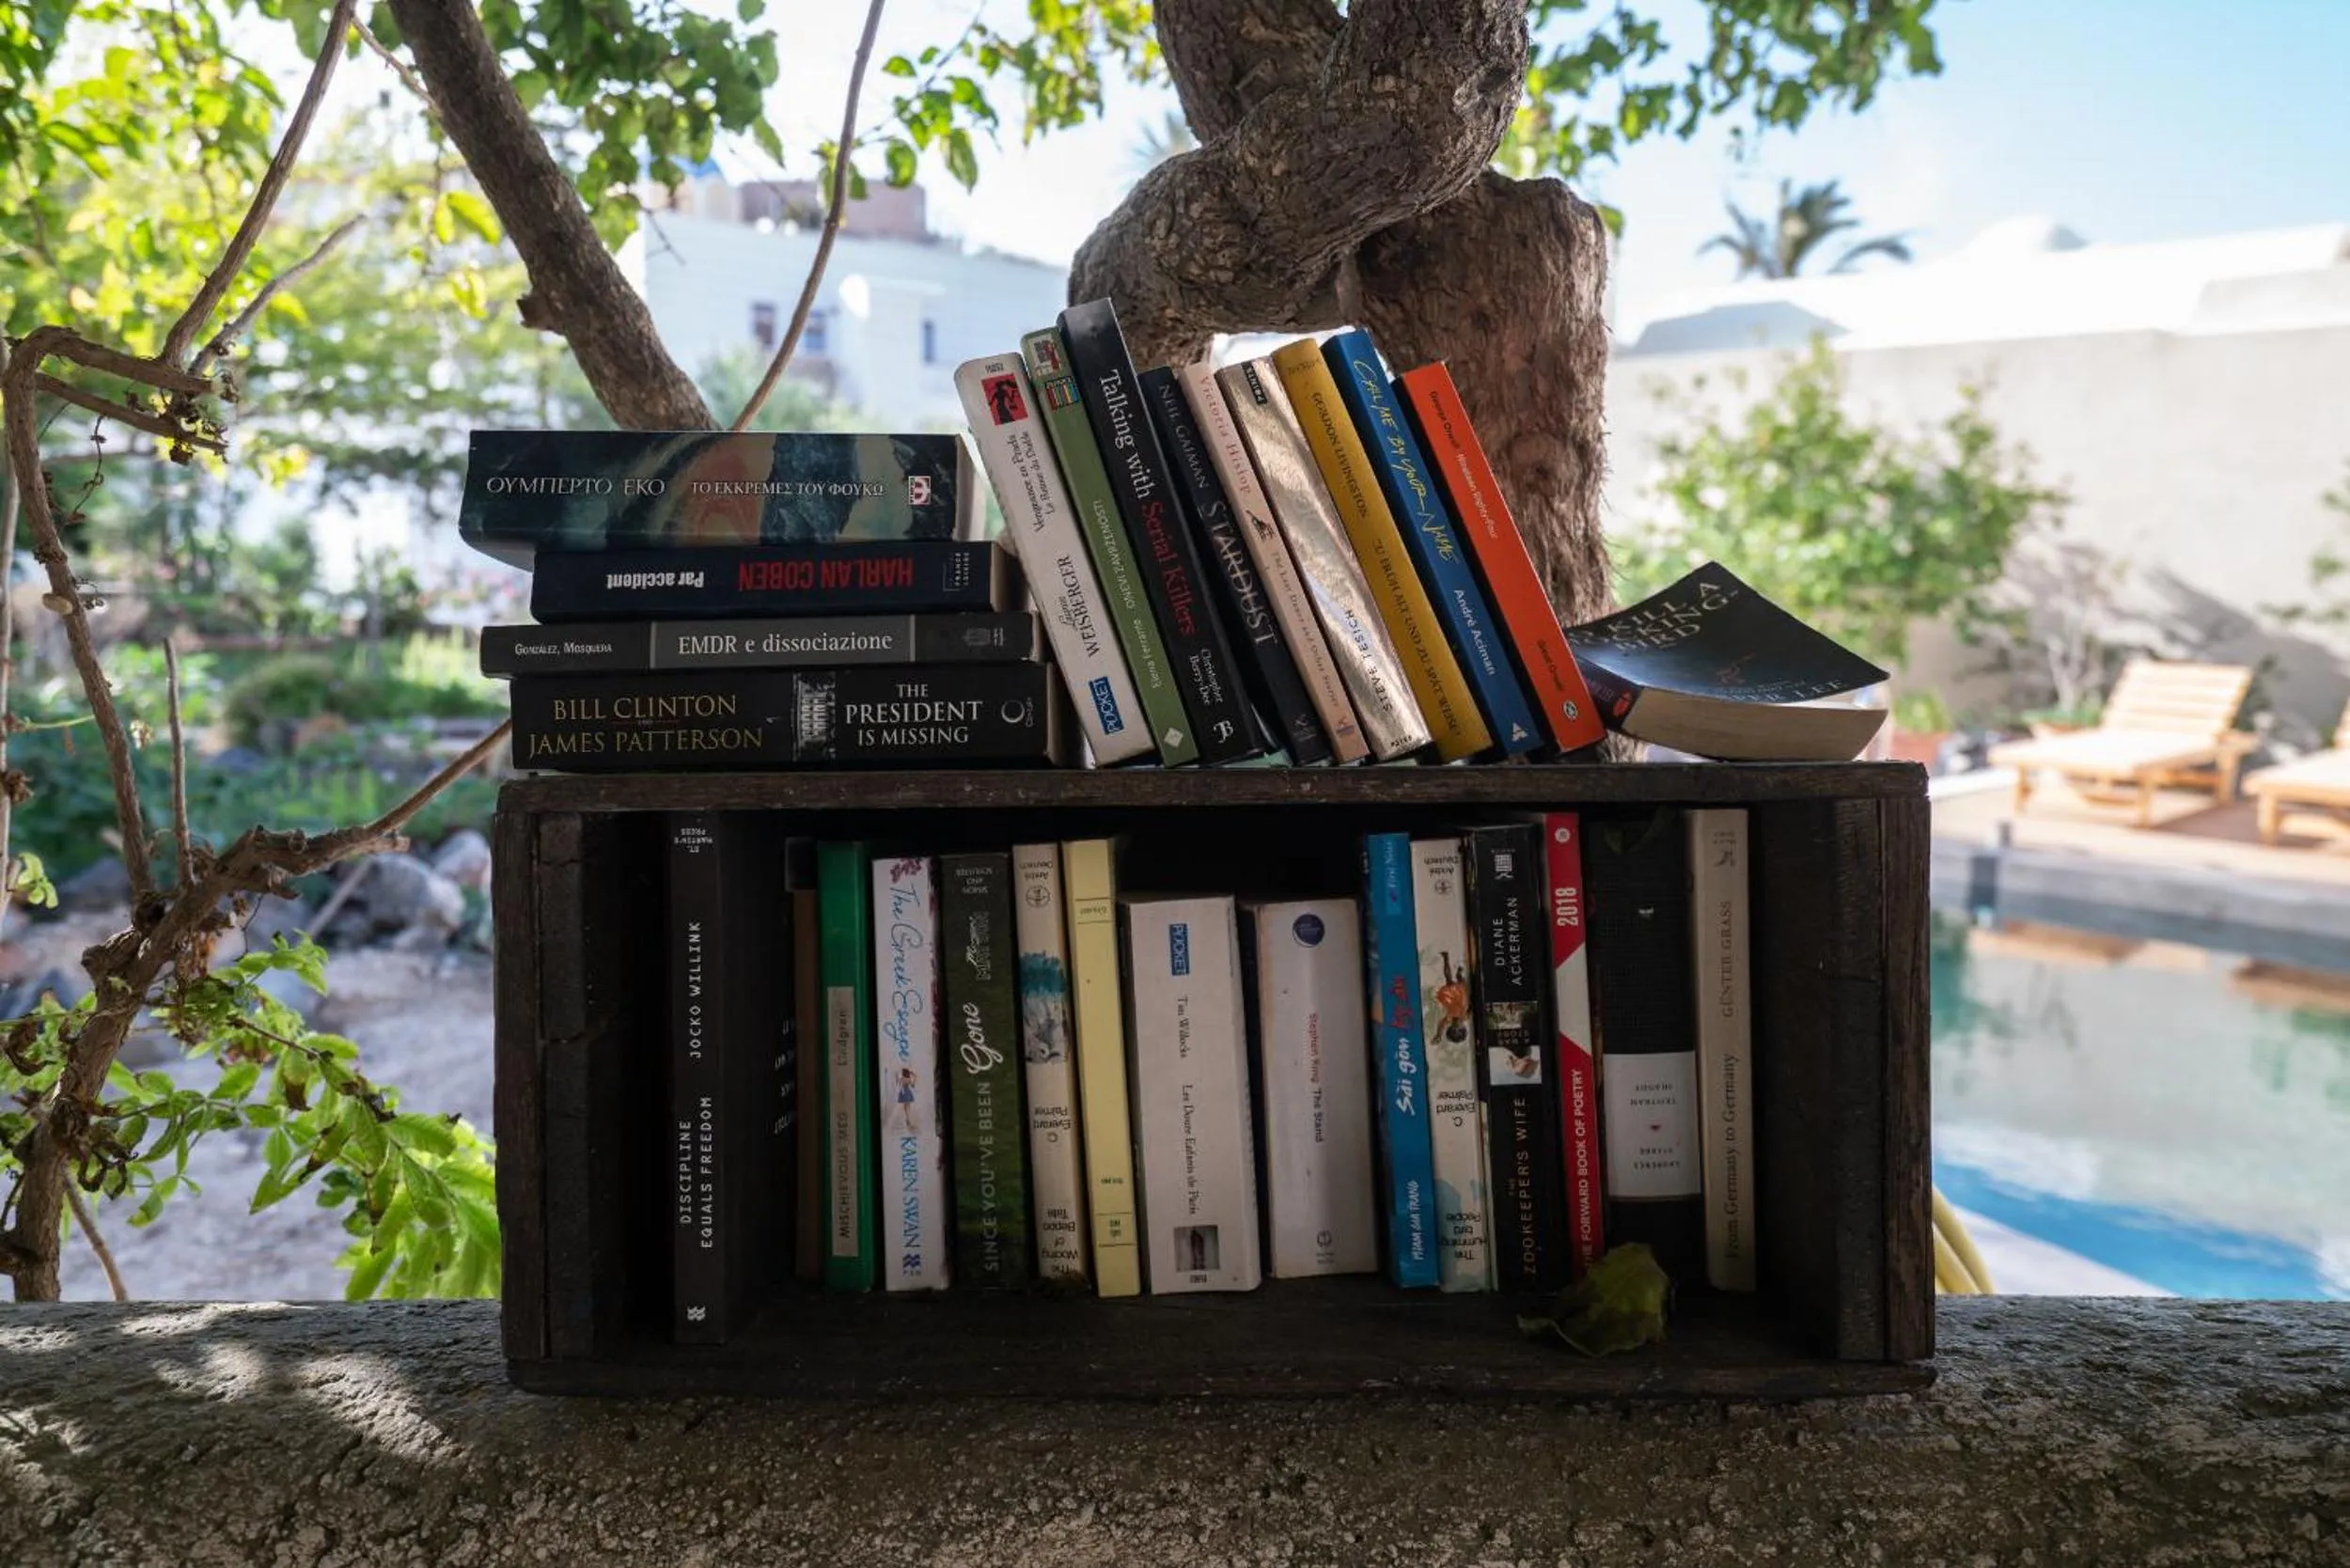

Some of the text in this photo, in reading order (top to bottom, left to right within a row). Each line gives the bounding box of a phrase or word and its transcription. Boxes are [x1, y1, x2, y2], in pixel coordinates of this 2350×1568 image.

[1007, 433, 1025, 464] Prada
[1158, 384, 1209, 489] NEIL GAIMAN
[1199, 376, 1251, 494] Victoria Hislop
[1311, 388, 1375, 519] GORDON LIVINGSTON
[1353, 360, 1383, 402] CALL
[1370, 404, 1397, 428] ME
[1390, 458, 1427, 515] YOUR
[1418, 511, 1454, 561] NAME
[486, 476, 666, 496] ΟΥΜΠΕΡΤΟ ΕΚΟ
[691, 481, 885, 498] ΤΟ ΕΚΚΡΕΜΕΣ ΤΟΥ ΦΟΥΚΩ
[1456, 453, 1477, 492] Nineteen
[1025, 482, 1045, 532] Vengeance
[1099, 368, 1199, 635] Talking with Serial Killers
[605, 570, 705, 589] Par accident
[737, 557, 915, 593] HARLAN COBEN
[1116, 574, 1136, 609] DNEVI
[1197, 502, 1277, 645] STARDUST
[1057, 556, 1100, 657] WEISBERGER
[1453, 589, 1496, 675] André Aciman
[677, 633, 893, 655] EMDR e dissociazione
[1133, 619, 1162, 689] Elena Ferrante
[1344, 608, 1395, 713] STEVE TESICH
[896, 683, 930, 698] THE
[1200, 648, 1224, 703] Christopher
[553, 695, 736, 721] BILL CLINTON
[845, 699, 982, 725] PRESIDENT
[1089, 674, 1125, 734] POCKET
[528, 728, 763, 760] JAMES PATTERSON
[858, 727, 969, 746] IS MISSING
[1554, 886, 1579, 929] 2018
[1717, 900, 1733, 950] GRASS
[1490, 917, 1507, 965] DIANE
[1504, 896, 1524, 987] ACKERMAN
[686, 922, 703, 1061] JOCKO WILLINK
[883, 883, 926, 1063] The Greek Escape
[956, 1000, 1004, 1074] Gone
[1175, 1017, 1193, 1058] Willocks
[1305, 1012, 1323, 1085] Stephen King
[1179, 1083, 1194, 1102] Les
[1310, 1088, 1325, 1143] The Stand
[1569, 1068, 1585, 1117] POETRY
[1572, 1118, 1587, 1137] OF
[677, 1121, 693, 1224] DISCIPLINE
[697, 1097, 715, 1247] EQUALS FREEDOM
[974, 1081, 1001, 1272] SINCE YOU'VE BEEN
[1574, 1137, 1590, 1176] BOOK
[1720, 1052, 1743, 1259] From Germany to Germany
[835, 1145, 853, 1239] MISCHIEVOUS
[899, 1136, 922, 1248] KAREN SWAN
[1185, 1189, 1200, 1216] Paris
[1505, 1176, 1517, 1197] THE
[1511, 1095, 1538, 1275] ZOOKEEPER'S WIFE
[1575, 1177, 1593, 1242] FORWARD
[1453, 1249, 1475, 1262] The
